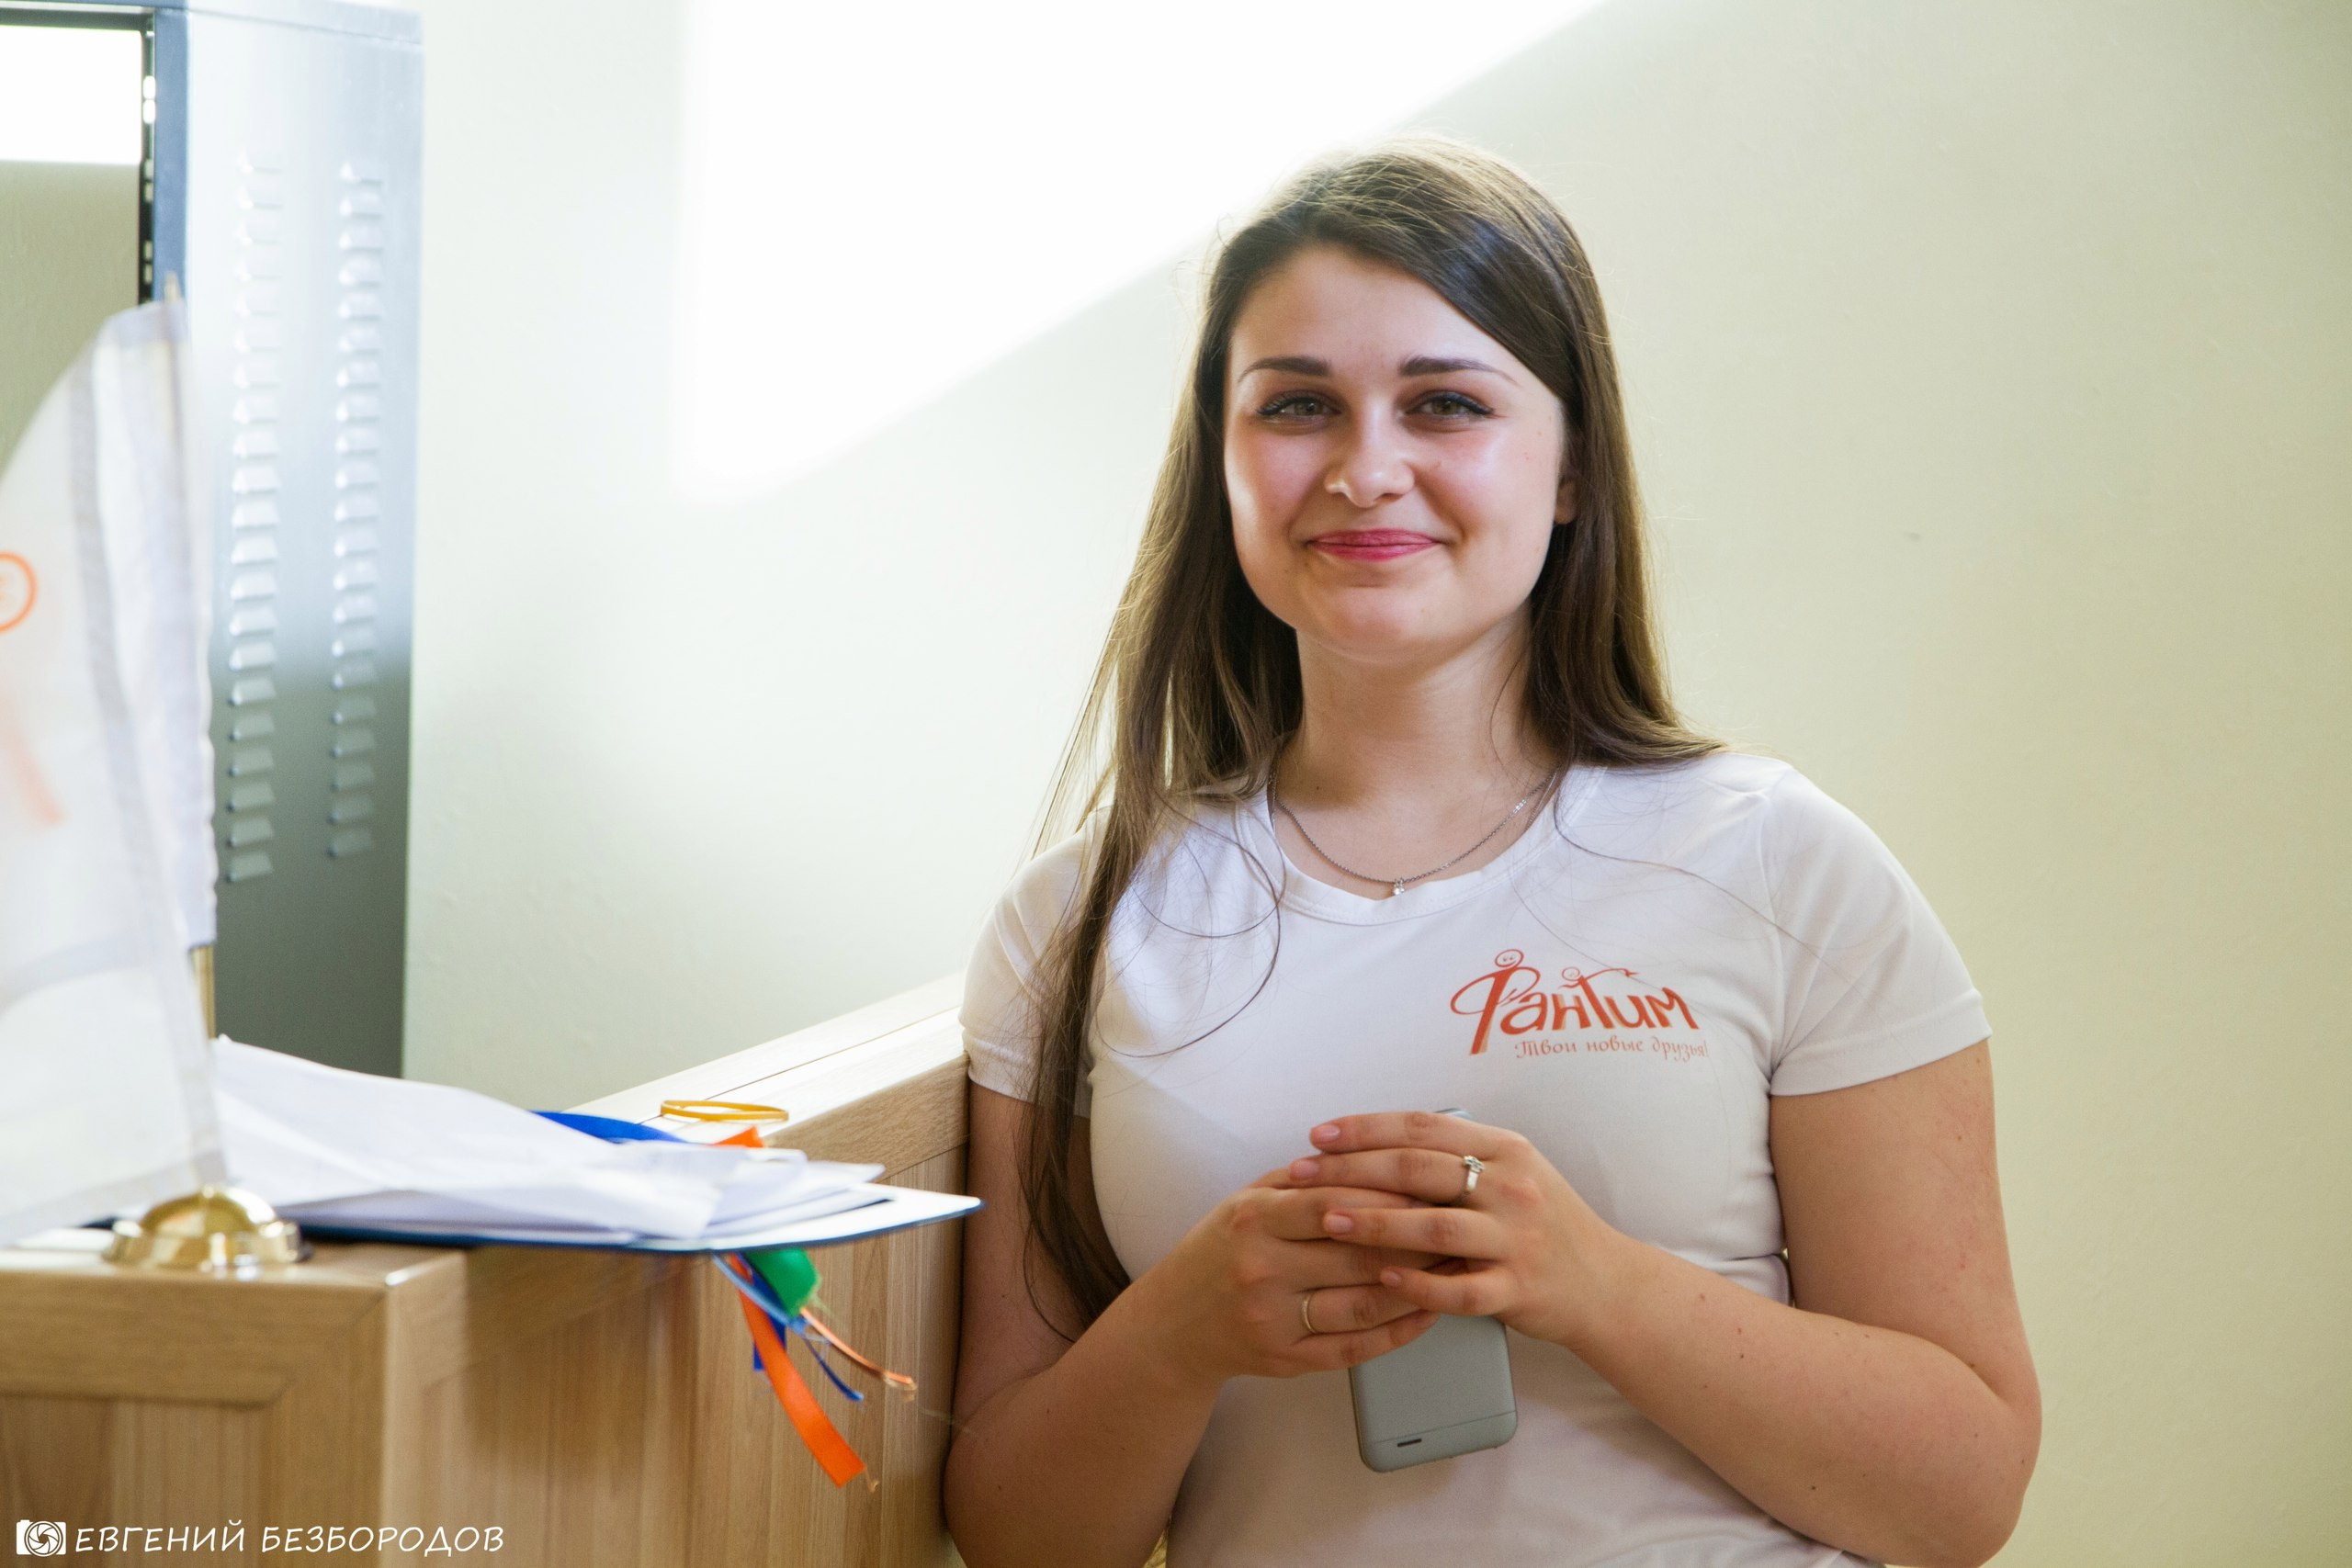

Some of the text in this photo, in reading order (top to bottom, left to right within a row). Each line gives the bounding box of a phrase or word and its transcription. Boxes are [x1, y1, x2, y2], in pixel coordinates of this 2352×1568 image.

[1514, 1034, 1710, 1062] Твои новые друзья!
